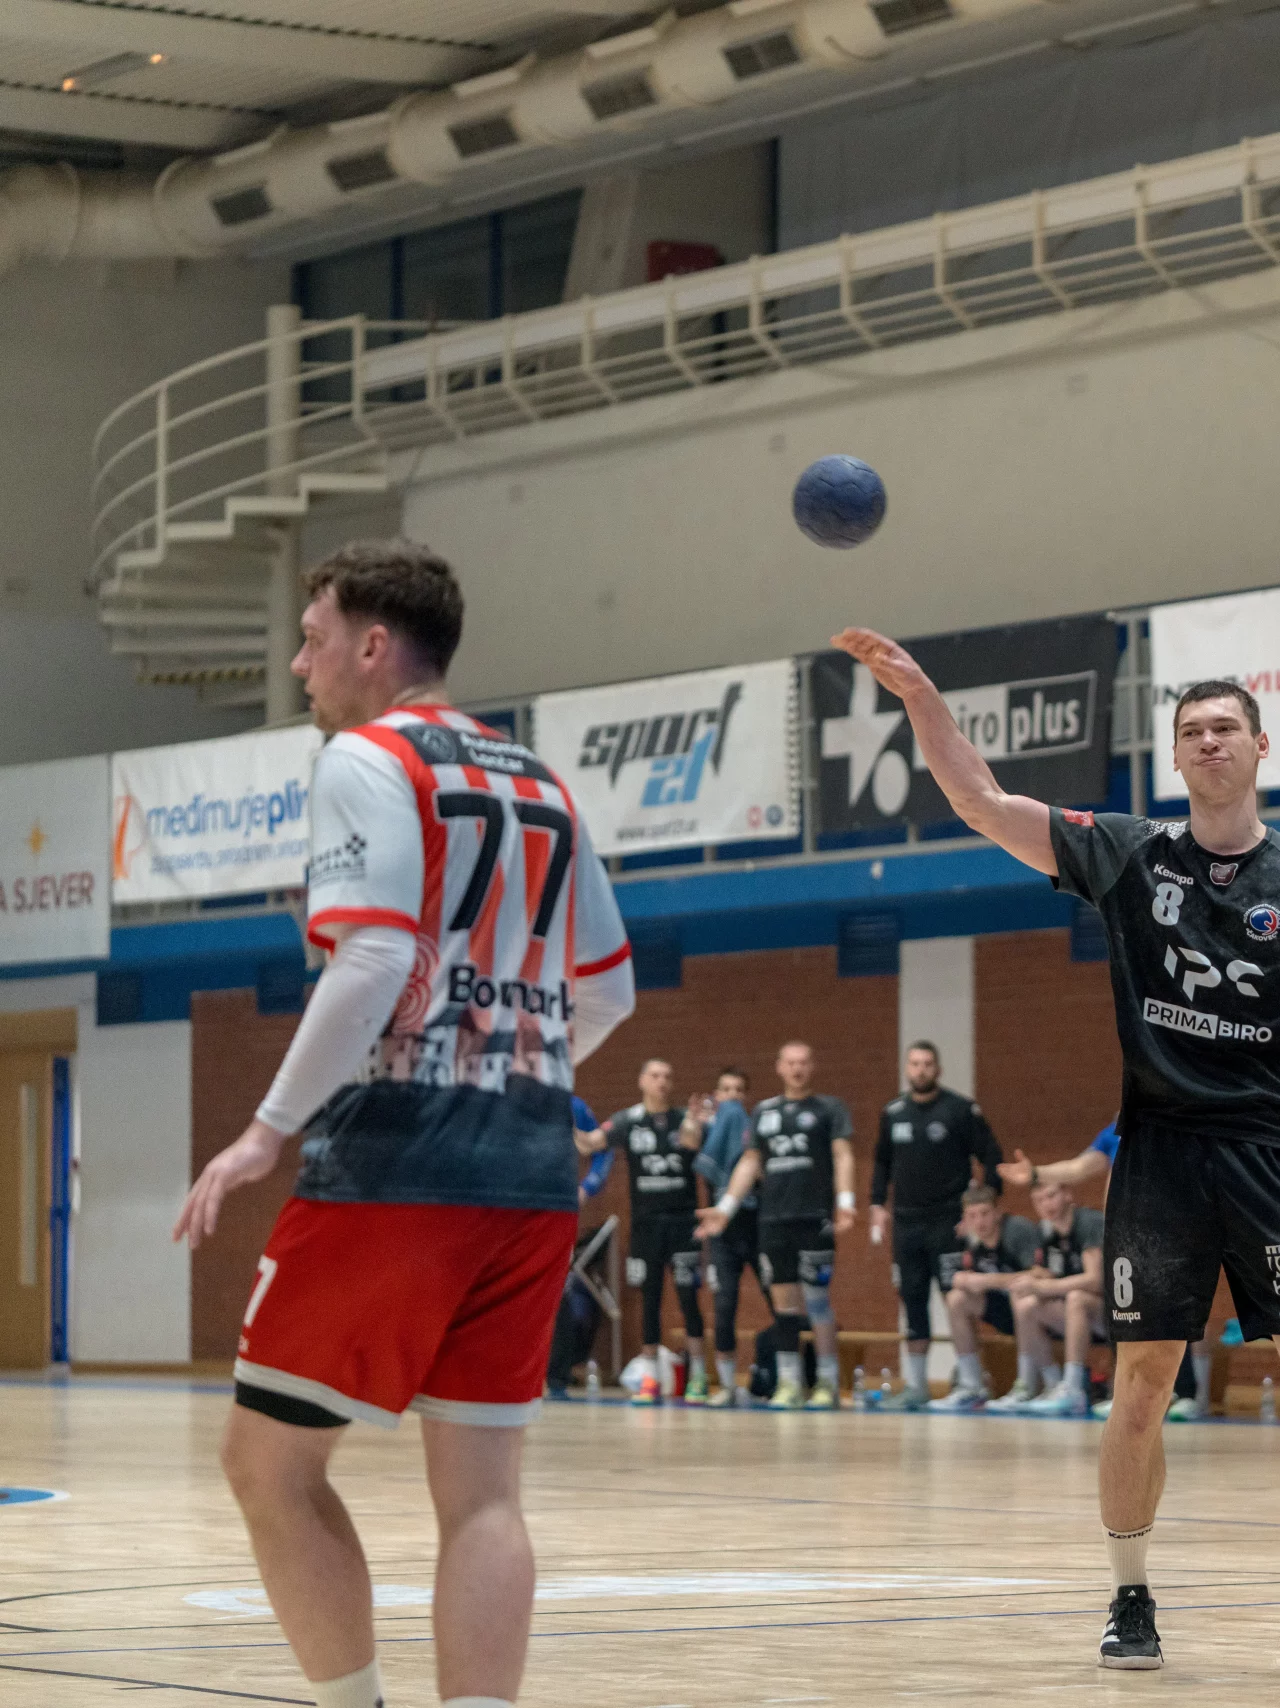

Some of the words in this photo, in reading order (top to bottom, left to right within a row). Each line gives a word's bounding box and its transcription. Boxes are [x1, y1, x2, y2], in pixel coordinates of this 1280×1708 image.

[957, 702, 1001, 747] iro
[1011, 691, 1081, 751] plus
[438, 792, 573, 939] 77
[1153, 863, 1194, 886] Kempa
[13, 872, 94, 913] SJEVER
[1151, 882, 1184, 926] 8
[1217, 1023, 1273, 1043] BIRO
[1113, 1257, 1133, 1308] 8
[1112, 1309, 1141, 1323] Kempa
